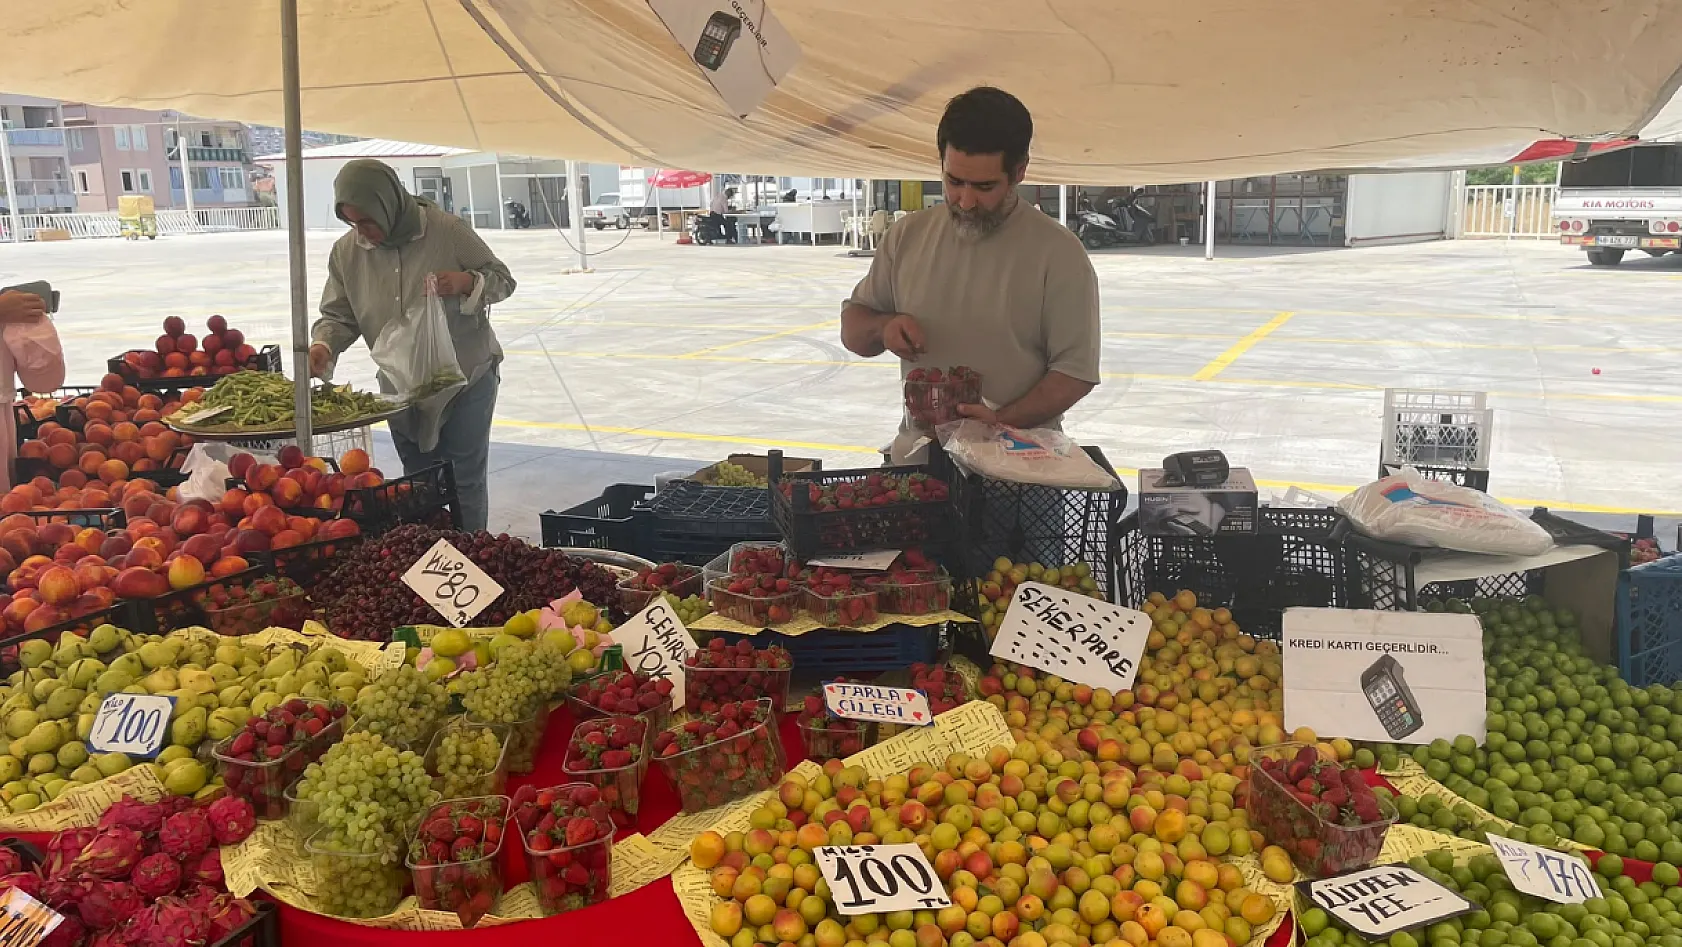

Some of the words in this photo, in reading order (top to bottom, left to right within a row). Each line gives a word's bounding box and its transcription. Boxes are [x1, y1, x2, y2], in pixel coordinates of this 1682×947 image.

[1582, 200, 1602, 208] KIA
[1605, 200, 1655, 208] MOTORS
[434, 572, 479, 608] 80
[1289, 638, 1324, 649] KREDİ
[1327, 640, 1363, 651] KARTI
[836, 685, 901, 701] TARLA
[106, 697, 161, 744] 100
[834, 854, 933, 908] 100
[1535, 852, 1597, 899] 170
